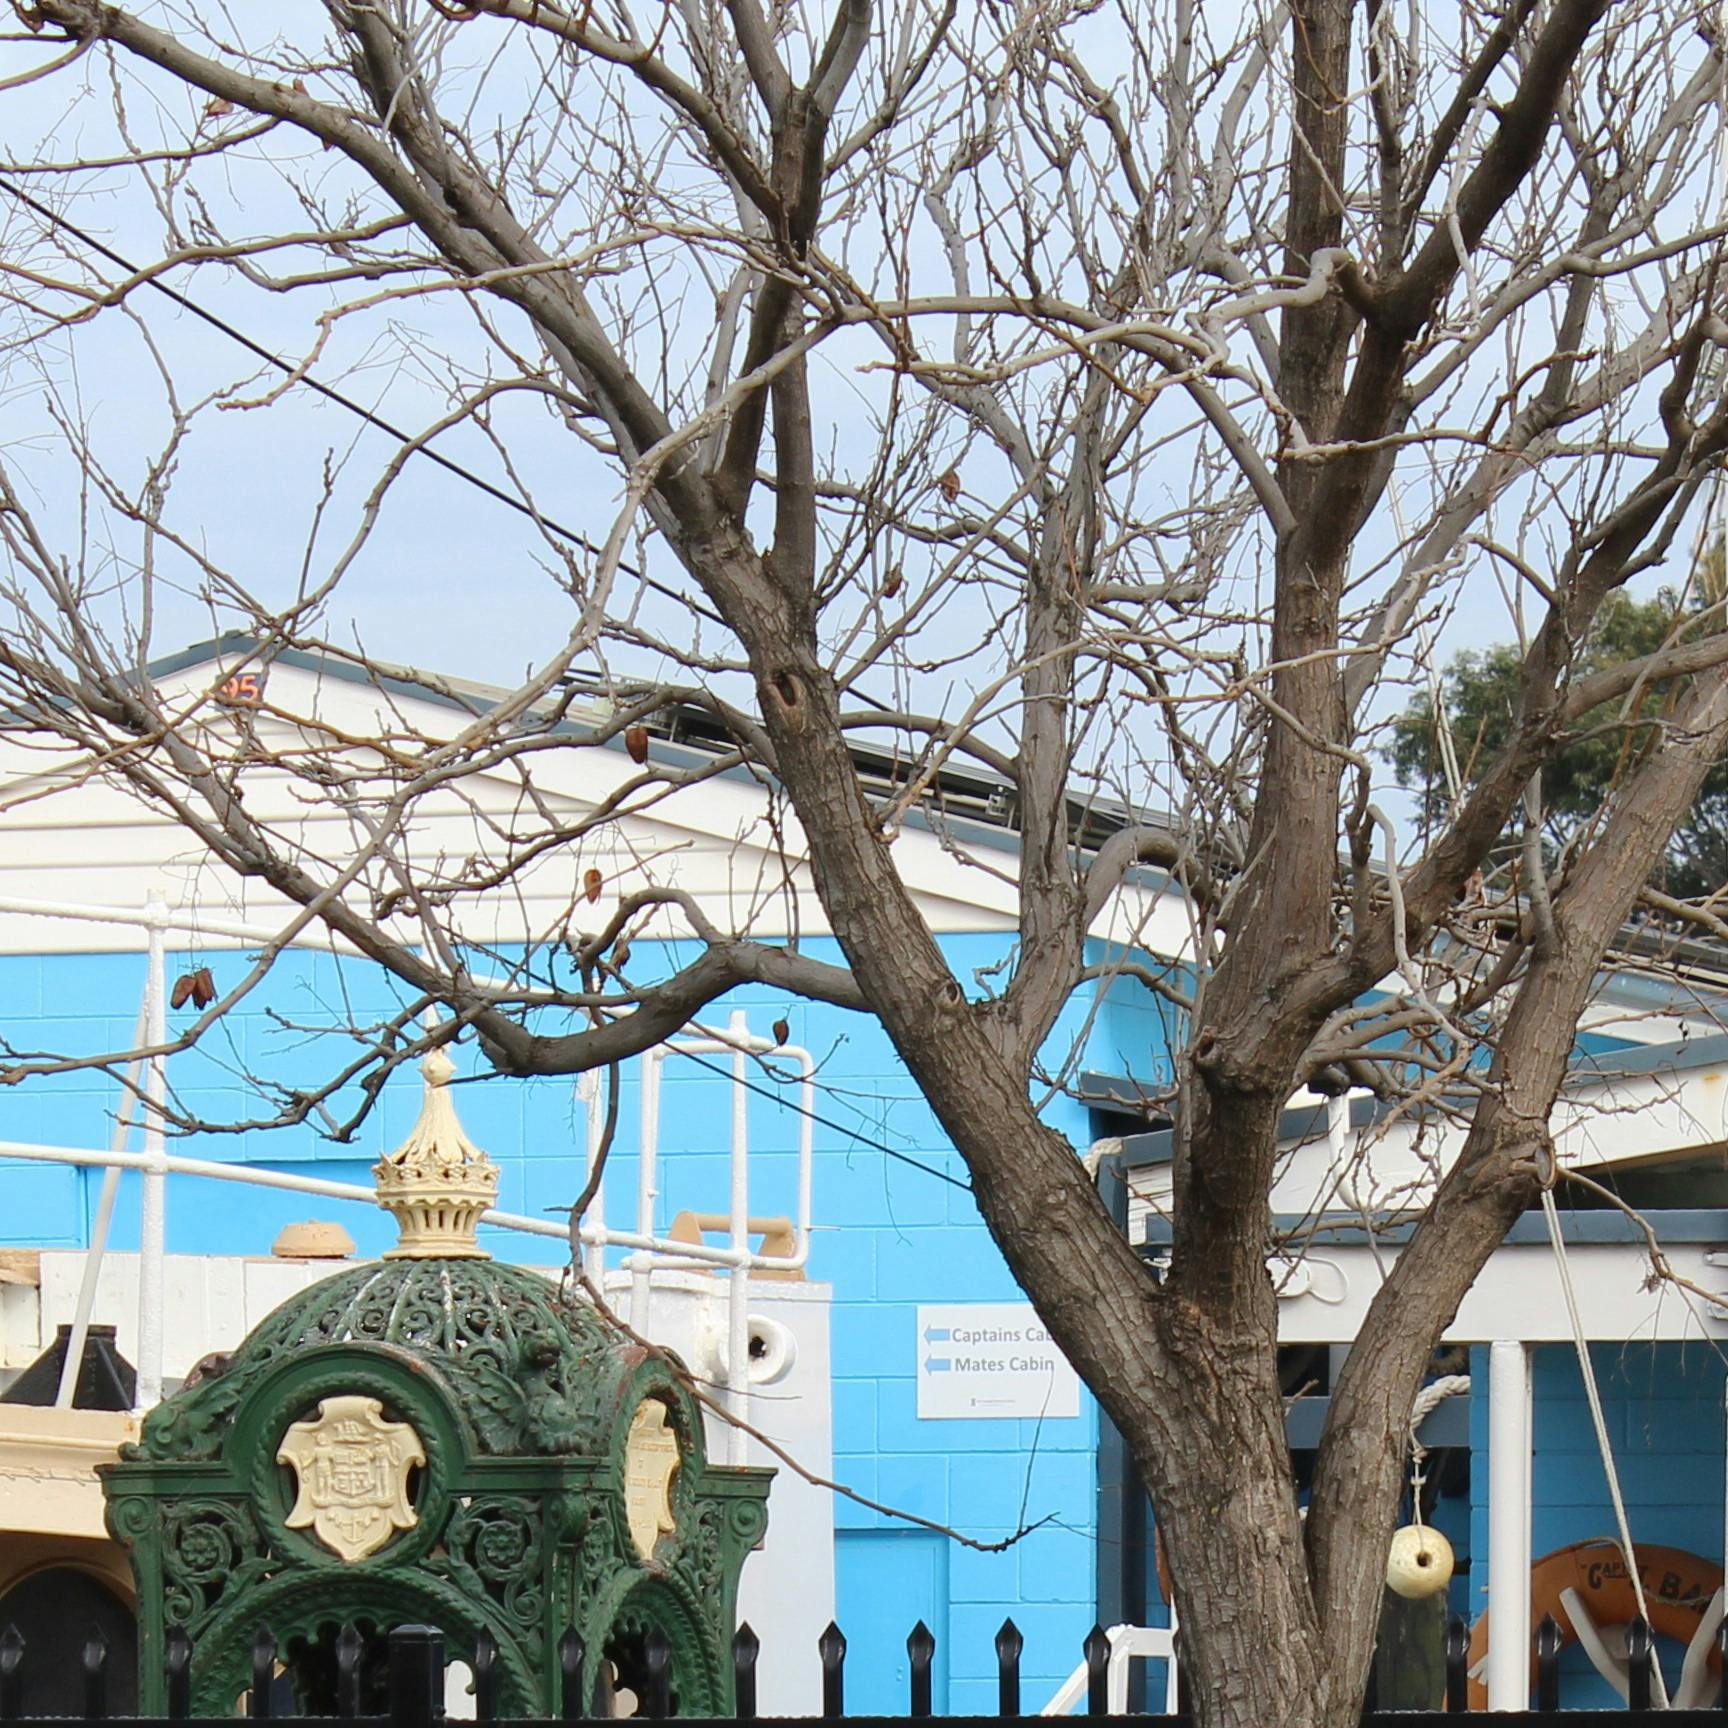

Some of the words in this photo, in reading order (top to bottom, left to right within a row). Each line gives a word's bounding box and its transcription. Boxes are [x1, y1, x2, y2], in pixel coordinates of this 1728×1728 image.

[952, 1327, 1021, 1345] Captains
[1025, 1327, 1055, 1342] Cab
[954, 1357, 1004, 1372] Mates
[1009, 1356, 1054, 1372] Cabin
